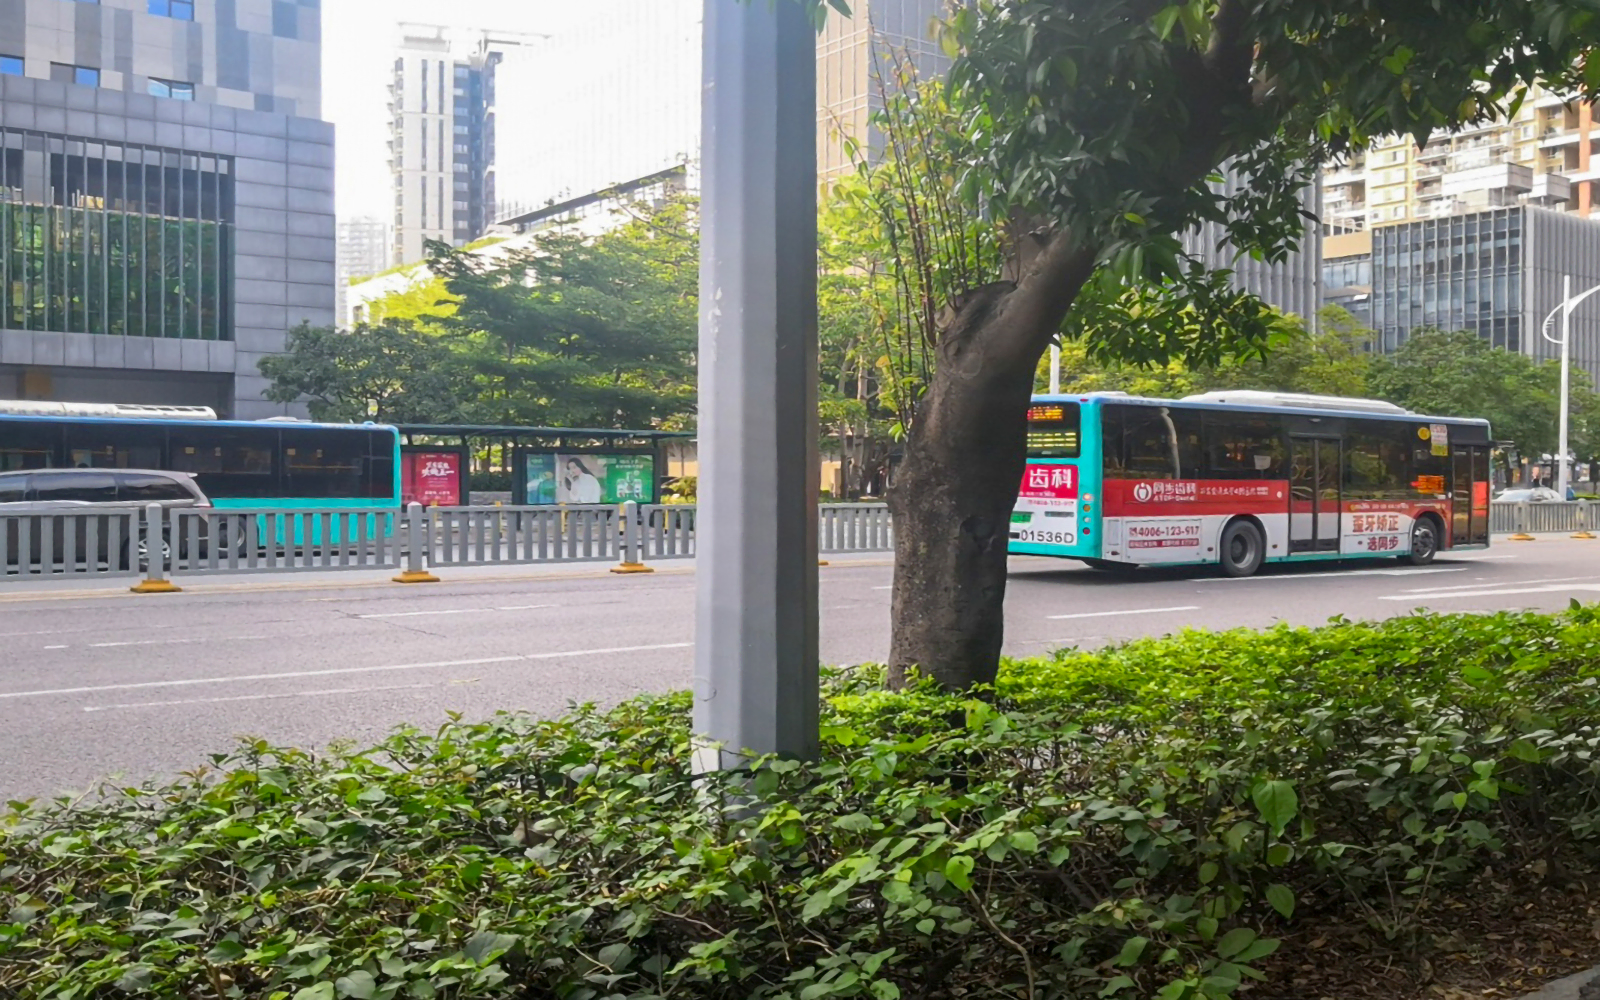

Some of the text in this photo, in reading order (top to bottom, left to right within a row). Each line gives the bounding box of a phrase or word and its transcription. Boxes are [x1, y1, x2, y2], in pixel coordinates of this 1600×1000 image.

[1029, 468, 1072, 489] 齿科
[1353, 515, 1399, 532] 歪牙矫正
[1021, 529, 1074, 544] 01536D
